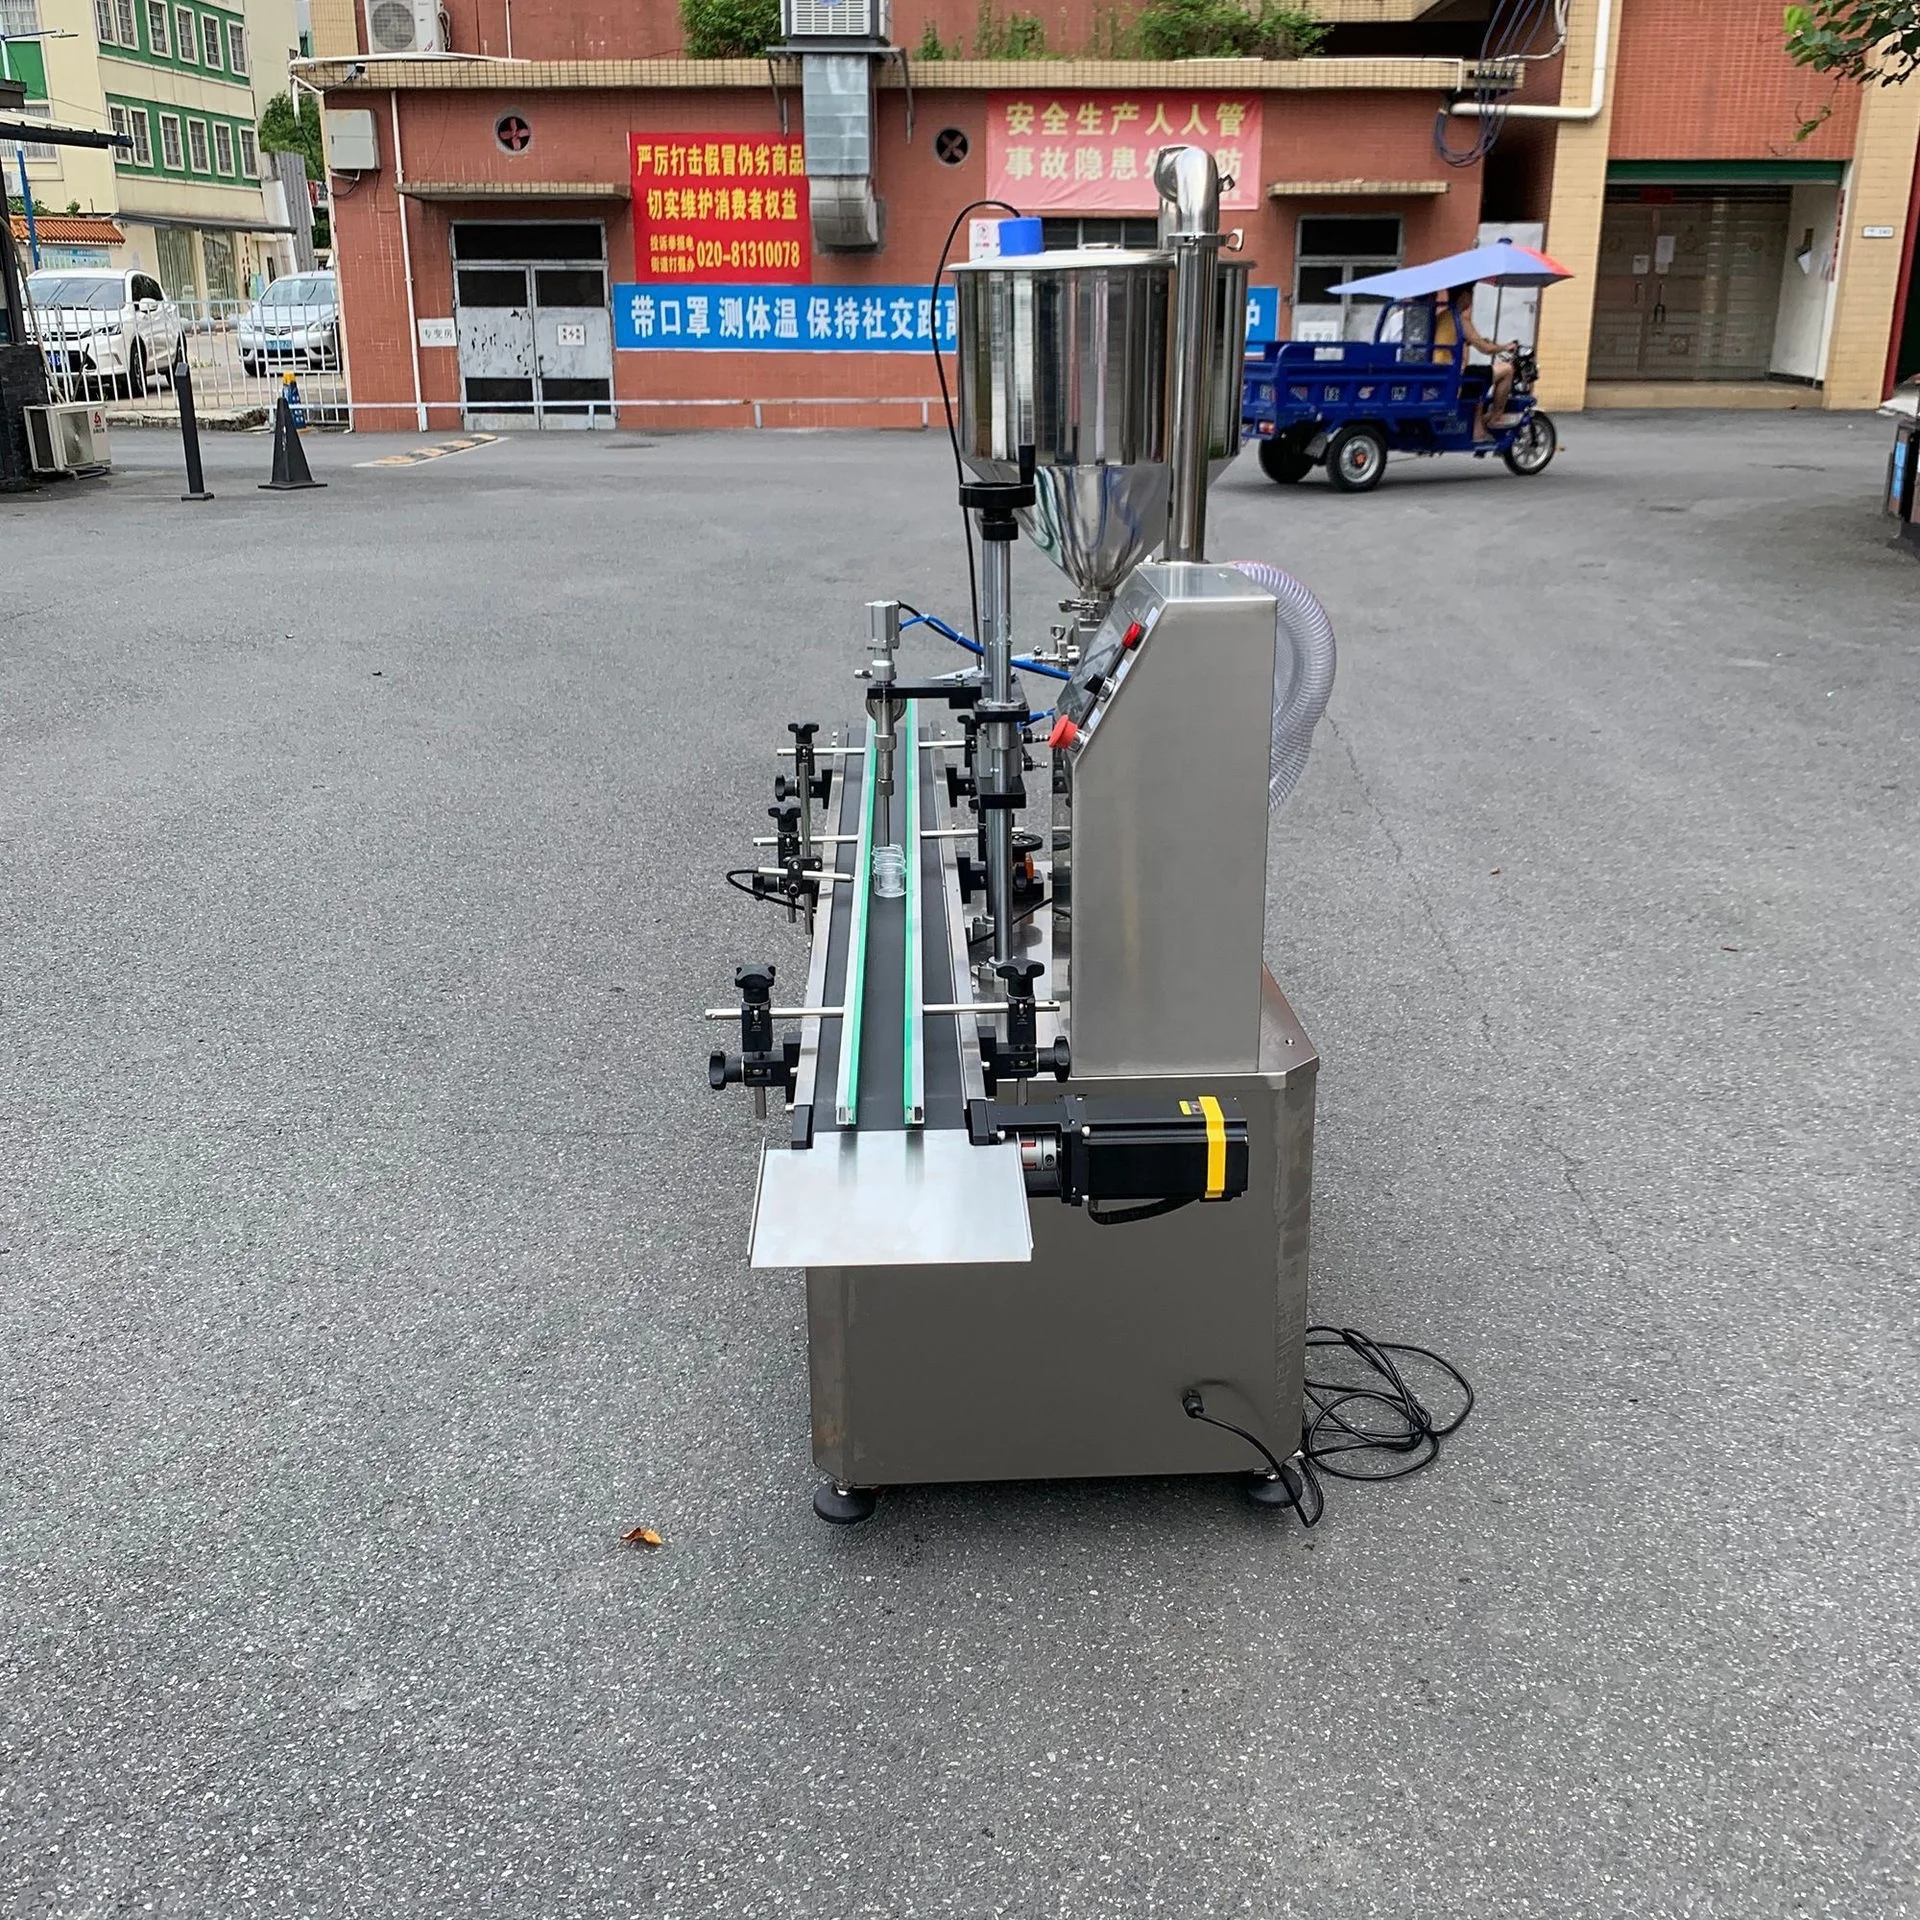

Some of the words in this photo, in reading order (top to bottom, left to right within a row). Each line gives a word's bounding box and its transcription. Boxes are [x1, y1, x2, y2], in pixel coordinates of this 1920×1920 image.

[1005, 102, 1246, 137] 安全生产人人管
[637, 144, 804, 177] 严厉打击假冒伪劣商品
[1004, 146, 1243, 181] 事故隐患防
[647, 187, 798, 220] 切实维护消费者权益
[697, 240, 800, 268] 020-81310078
[631, 295, 711, 338] 带口罩
[719, 296, 799, 339] 测体温
